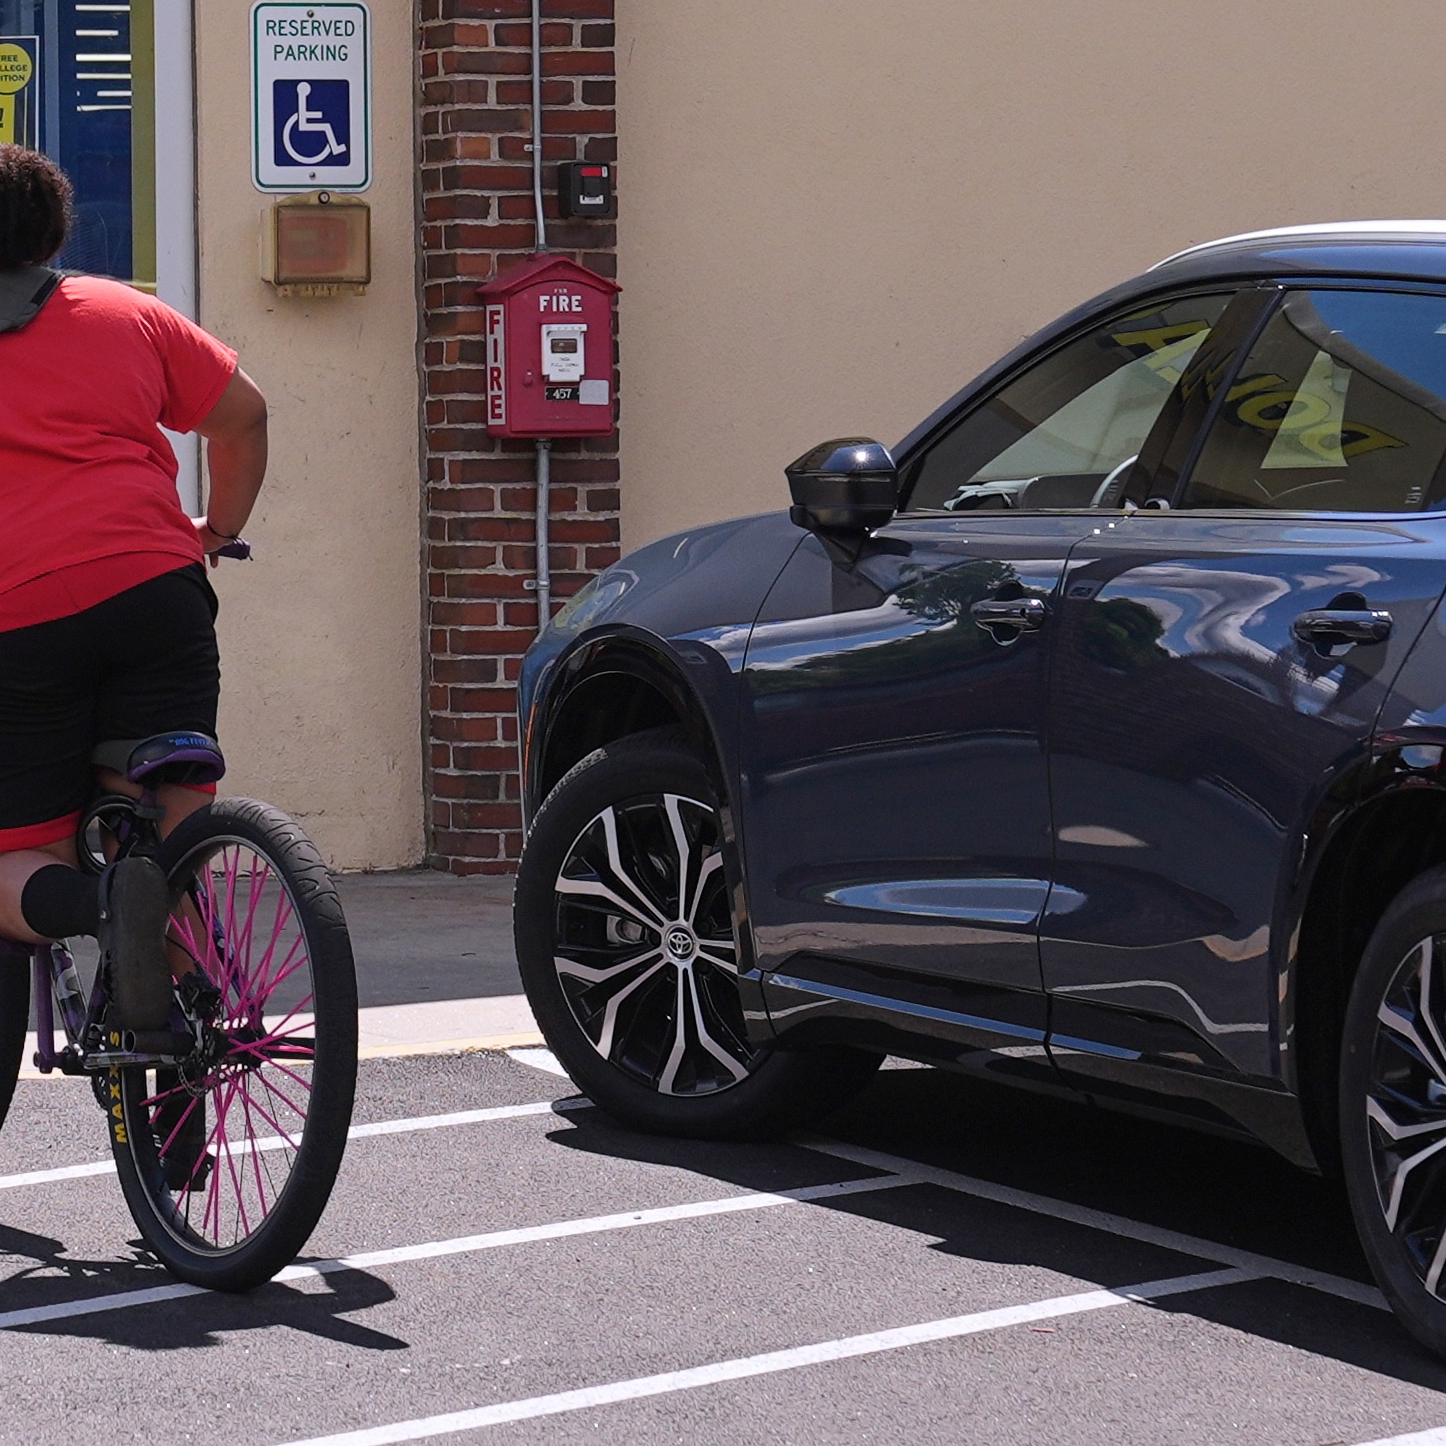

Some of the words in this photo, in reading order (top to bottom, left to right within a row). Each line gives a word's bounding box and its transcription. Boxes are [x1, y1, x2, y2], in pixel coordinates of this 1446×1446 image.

[266, 19, 355, 36] RESERVED
[273, 44, 348, 61] PARKING
[539, 295, 583, 312] FIRE
[489, 309, 503, 420] FIRE
[553, 388, 572, 399] 457
[109, 1031, 128, 1144] MAXXS
